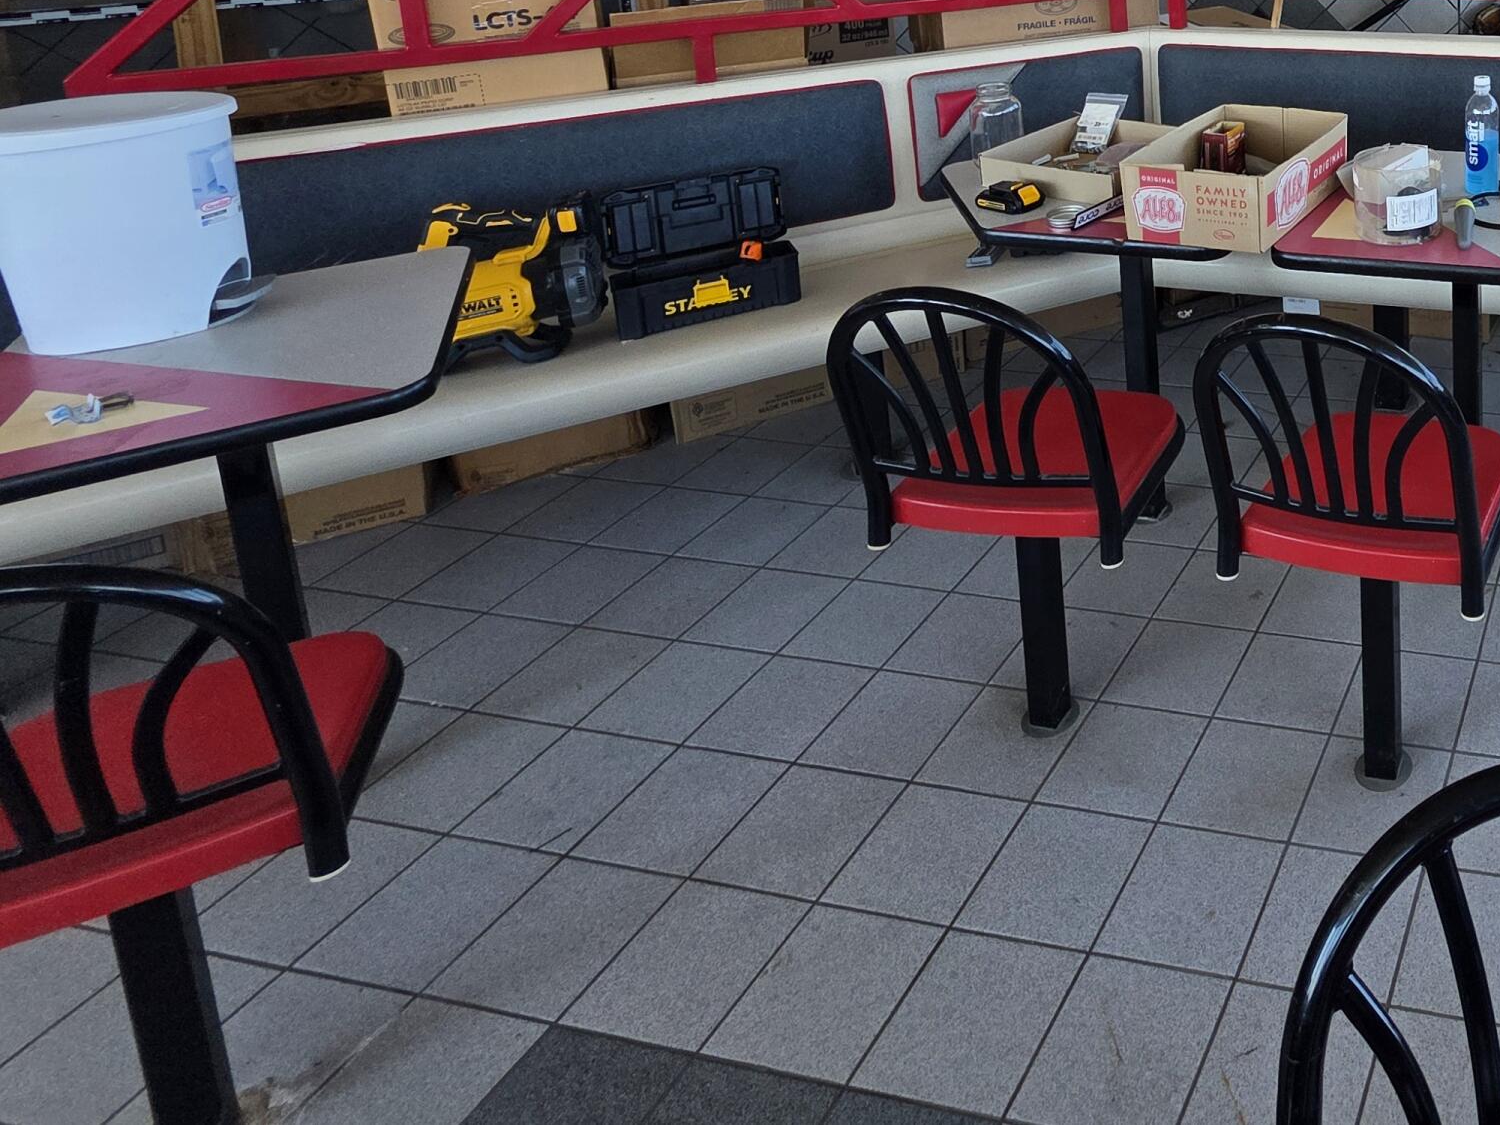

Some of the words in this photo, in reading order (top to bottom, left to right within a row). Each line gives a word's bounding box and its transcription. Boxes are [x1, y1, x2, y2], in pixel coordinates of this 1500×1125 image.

[1017, 20, 1056, 31] FRAGILE
[1064, 15, 1096, 26] FRÁGIL
[1467, 120, 1479, 165] smart
[1313, 149, 1344, 179] ORIGINAL
[1141, 175, 1176, 185] ORIGINAL
[1195, 185, 1247, 198] FAMILY
[1196, 198, 1248, 210] OWNED
[1196, 209, 1224, 217] SINCE
[1229, 211, 1249, 219] 1902
[463, 296, 501, 314] WALT
[665, 284, 752, 316] STAEY
[790, 398, 804, 406] THE
[314, 524, 343, 536] MADE
[358, 516, 377, 525] THE
